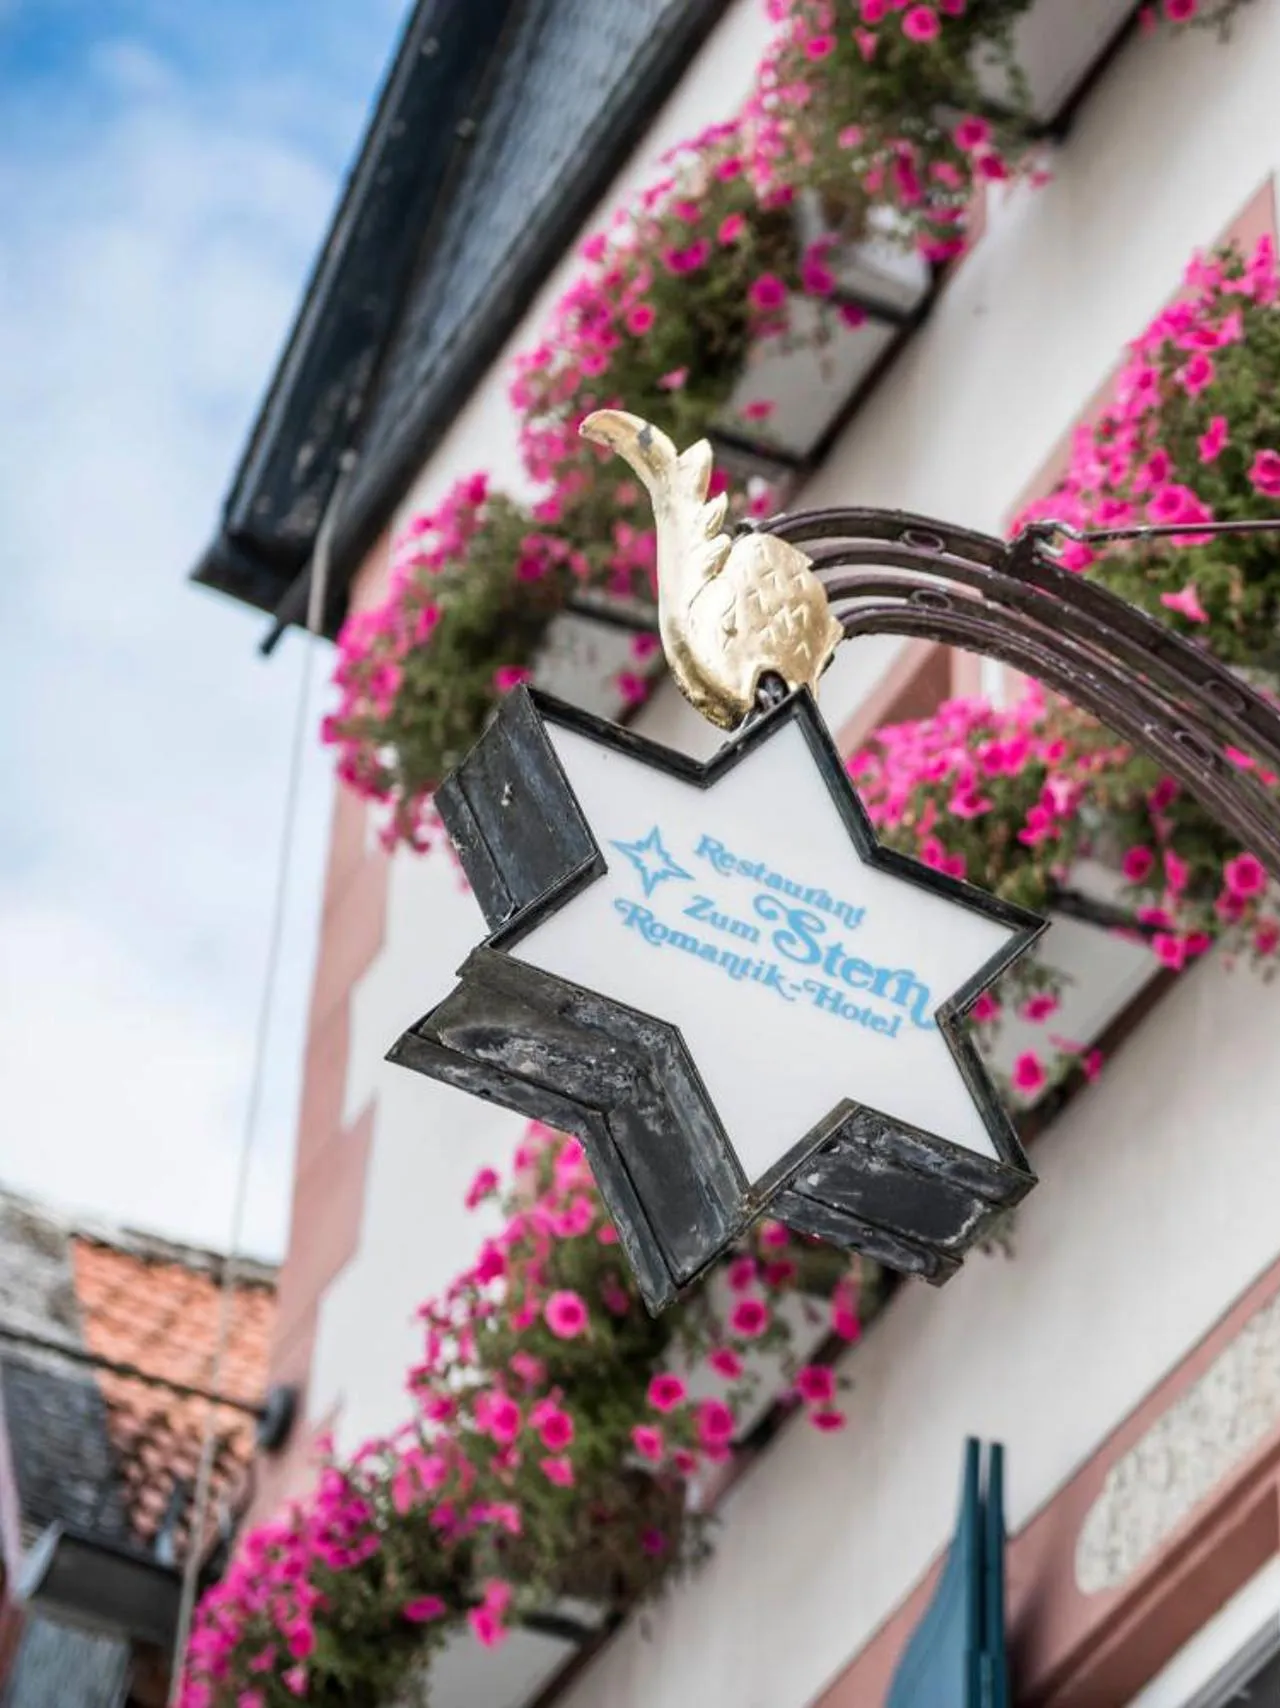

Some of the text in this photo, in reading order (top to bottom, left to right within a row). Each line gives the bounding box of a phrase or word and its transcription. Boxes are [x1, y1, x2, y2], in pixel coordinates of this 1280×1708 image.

[694, 833, 867, 931] Restaurant
[613, 897, 903, 1039] Romantik-Hotel
[682, 892, 939, 1031] Zum Stern
